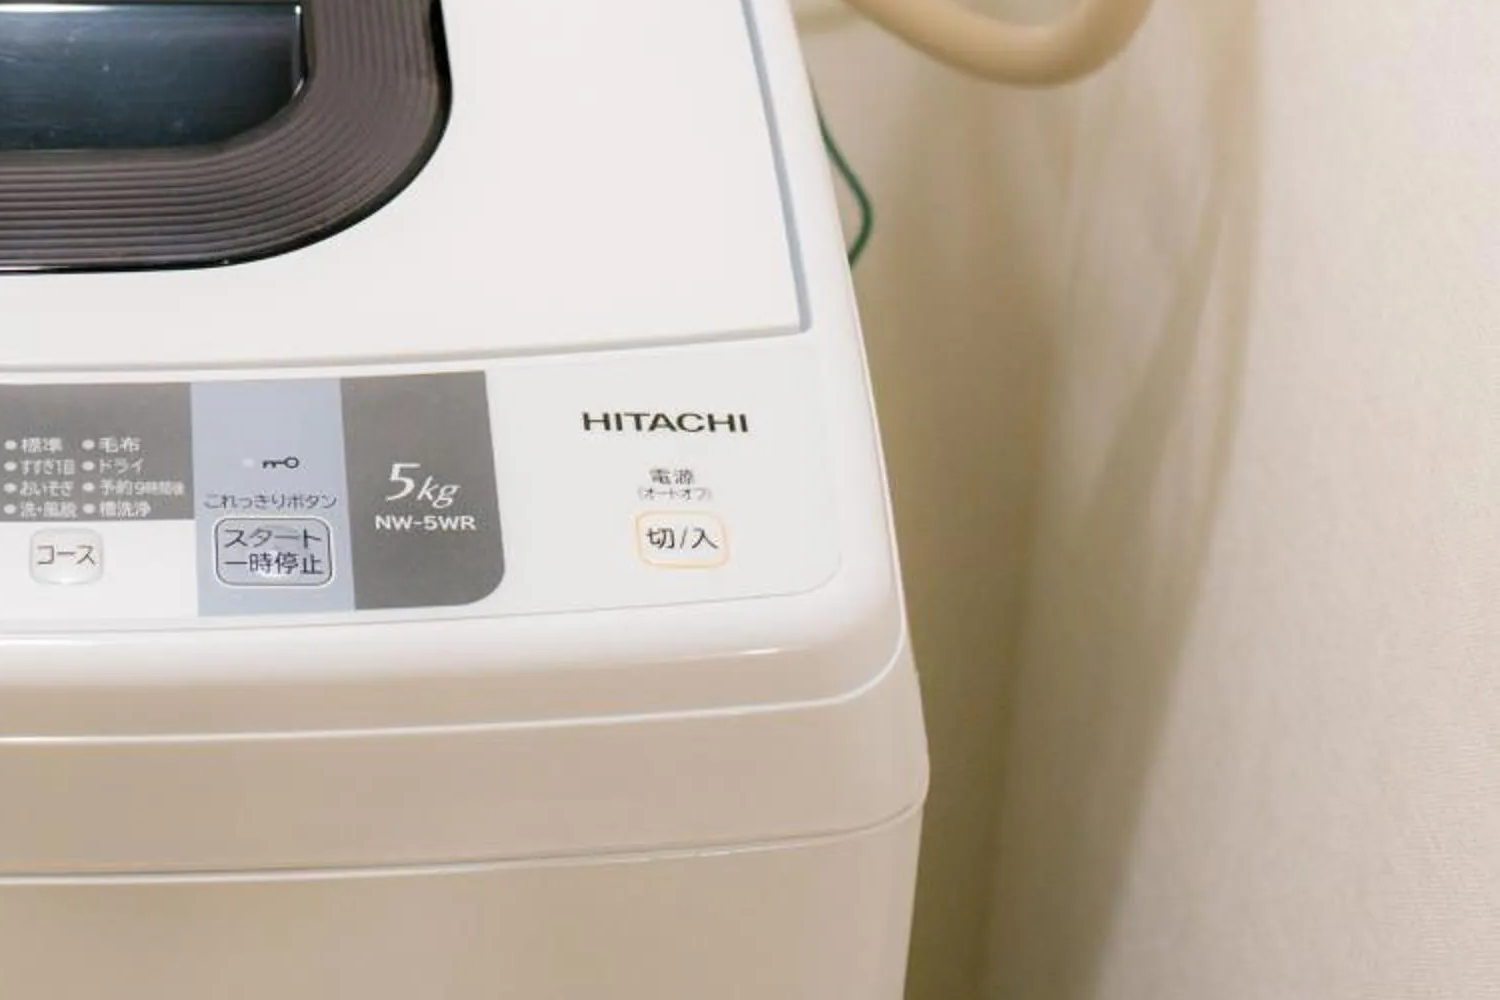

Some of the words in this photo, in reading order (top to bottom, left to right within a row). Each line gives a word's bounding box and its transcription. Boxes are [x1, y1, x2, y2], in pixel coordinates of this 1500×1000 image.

[583, 412, 749, 433] HITACHI
[21, 437, 63, 453] 標準
[100, 437, 141, 453] 毛布
[100, 458, 145, 475] ドライ
[649, 468, 695, 484] 電源
[204, 493, 337, 510] これっきりボタン
[375, 515, 476, 531] NW-5WR
[224, 528, 321, 548] スタート
[646, 527, 719, 550] 切/入
[37, 545, 96, 565] コース
[224, 552, 324, 575] 一時停止
